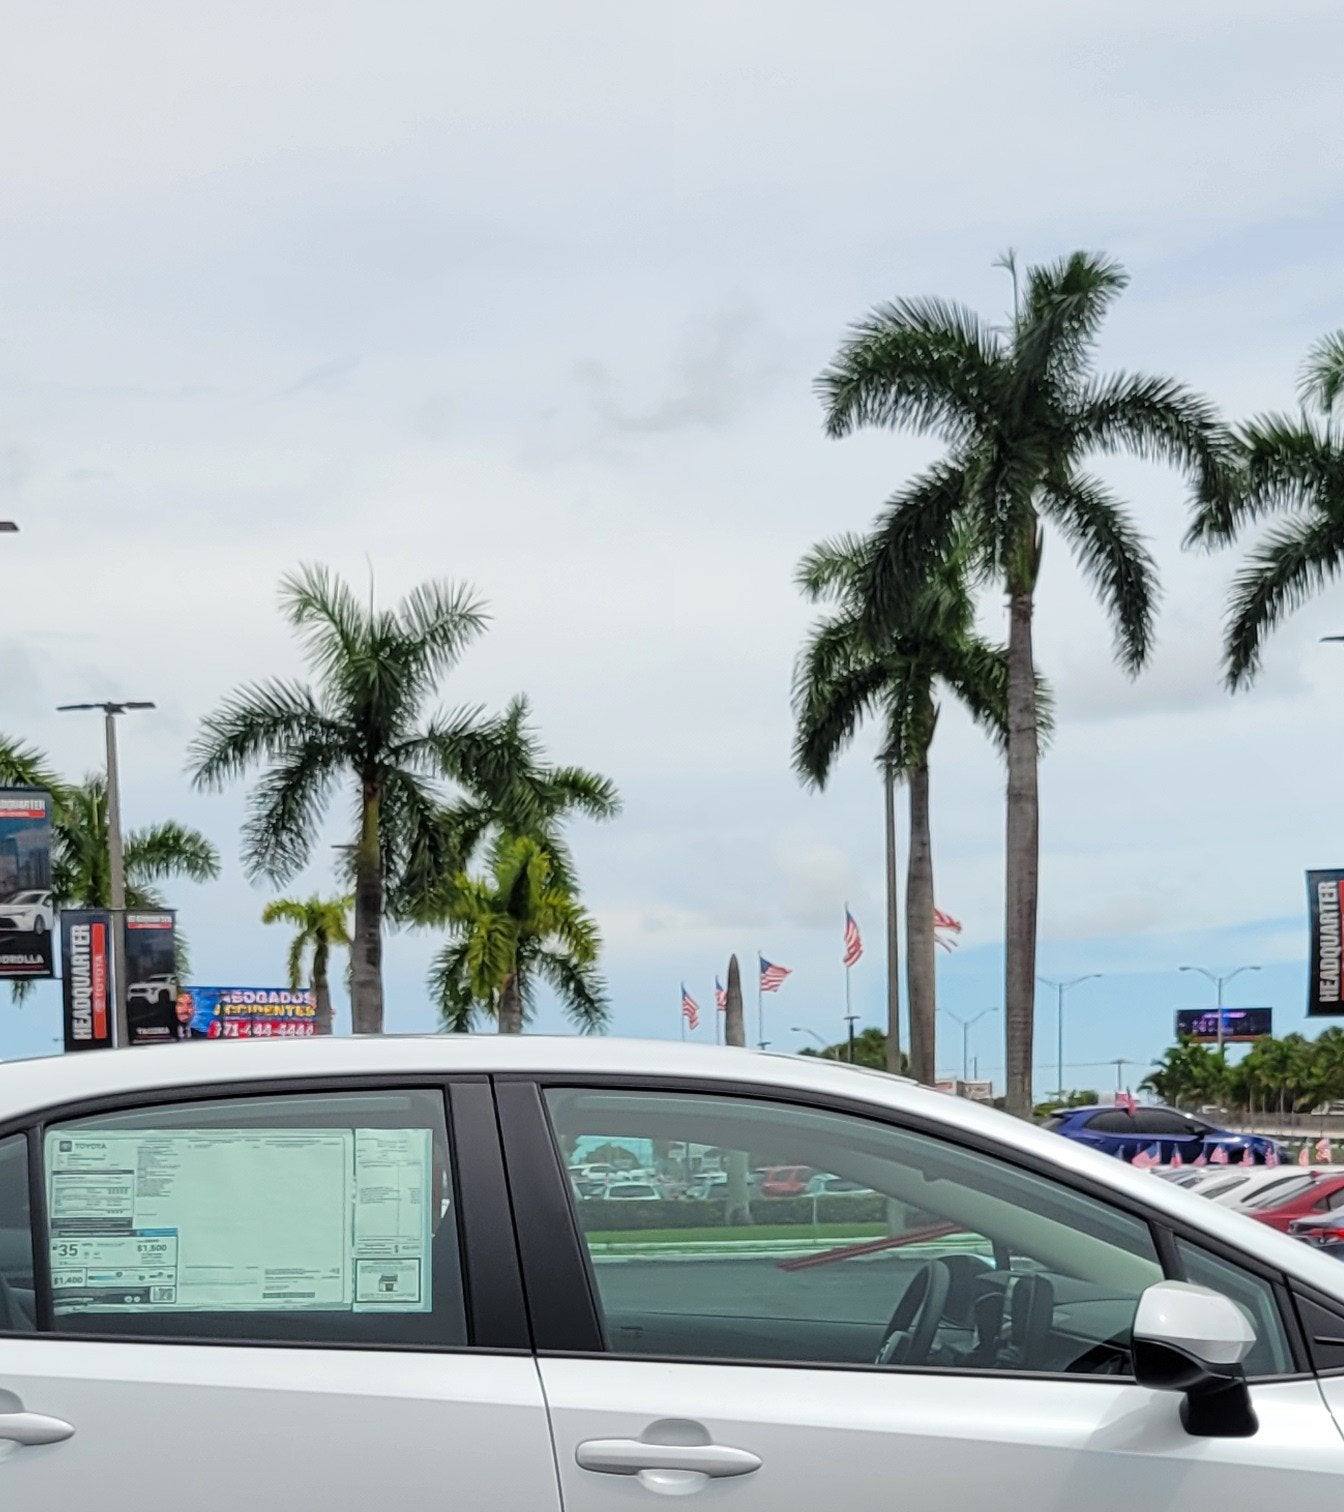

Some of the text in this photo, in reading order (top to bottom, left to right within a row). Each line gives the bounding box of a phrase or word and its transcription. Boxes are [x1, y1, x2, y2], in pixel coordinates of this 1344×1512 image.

[70, 924, 93, 1040] HEADQUARTER
[1318, 881, 1341, 1002] HEADQUARTER
[58, 1243, 78, 1257] 35
